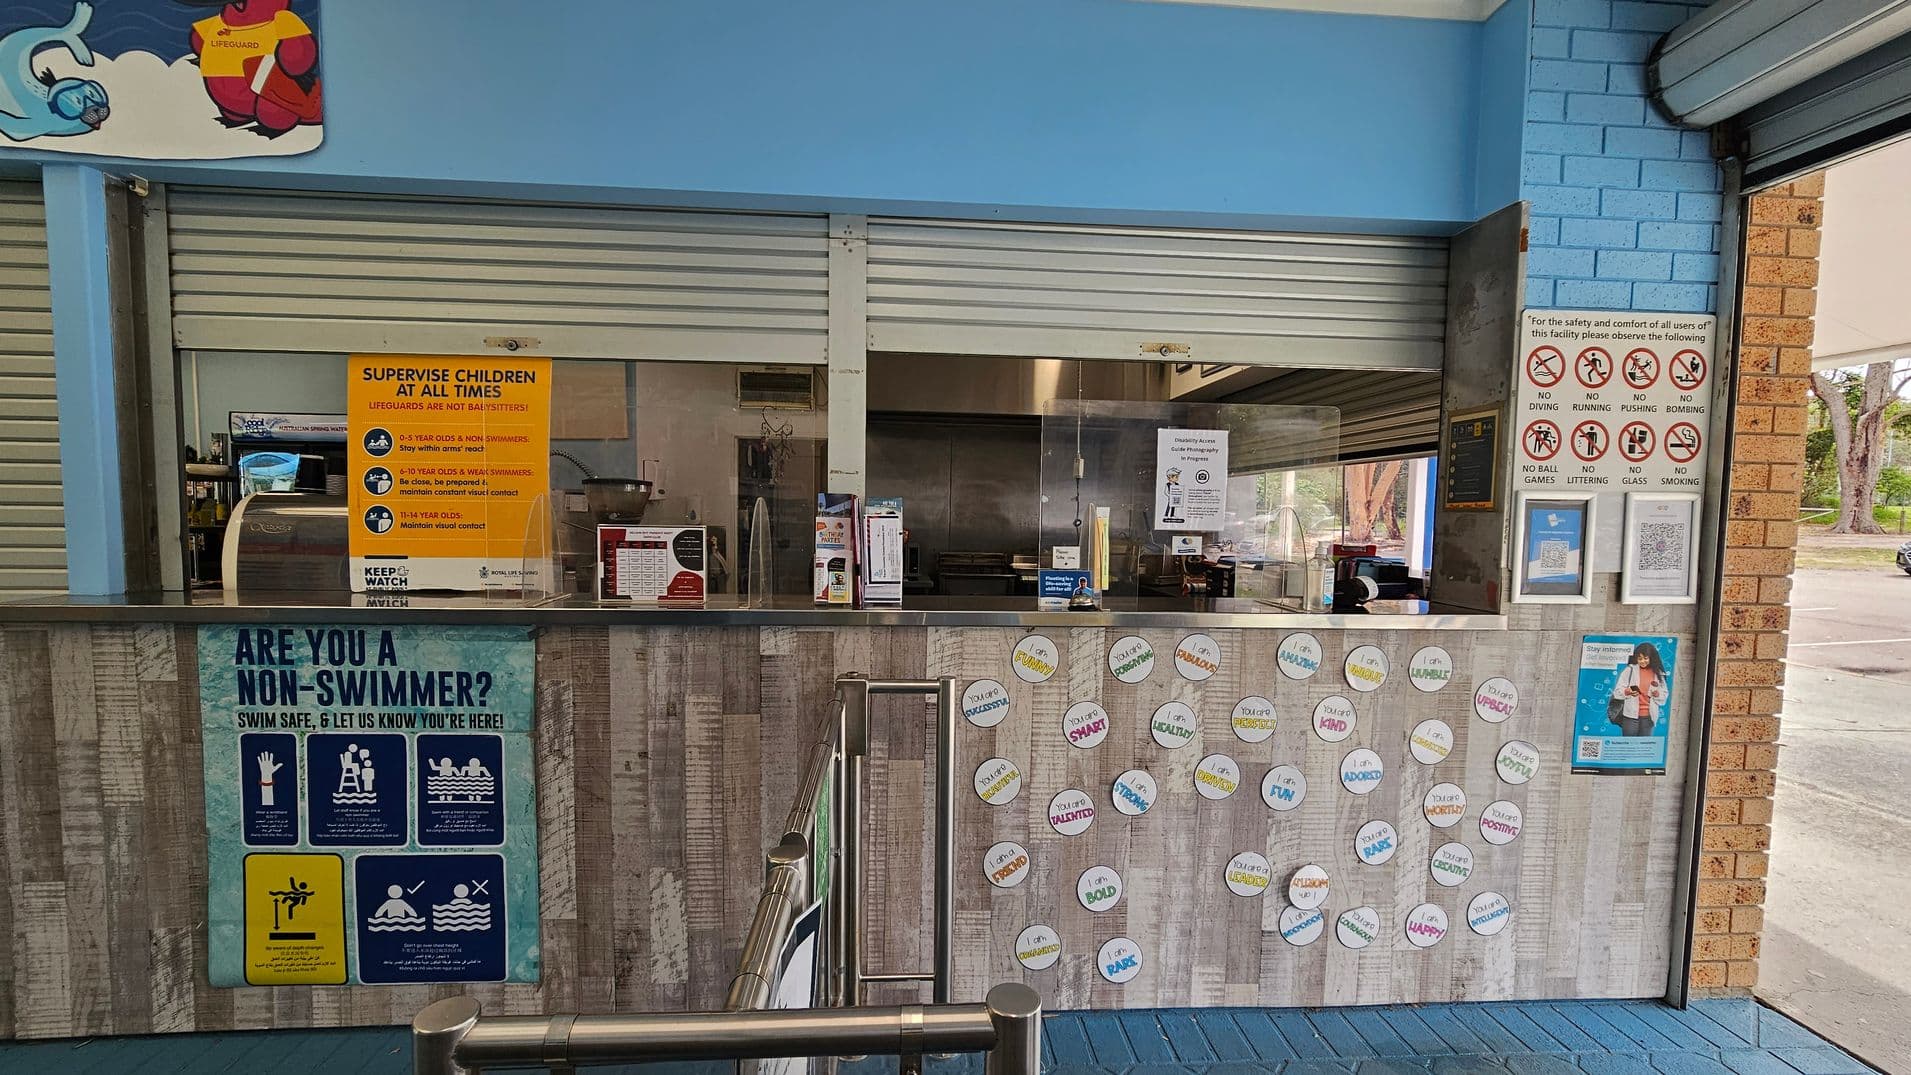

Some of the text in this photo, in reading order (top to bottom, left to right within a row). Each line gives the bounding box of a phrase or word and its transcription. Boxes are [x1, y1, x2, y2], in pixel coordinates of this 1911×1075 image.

[211, 40, 259, 49] LIFEGUARD
[1531, 317, 1546, 326] For
[1549, 318, 1563, 326] the
[1565, 318, 1592, 328] safety
[1594, 319, 1610, 327] and
[1613, 319, 1647, 328] comfort
[1650, 320, 1659, 329] of
[1661, 321, 1671, 329] all
[1532, 330, 1706, 344] this facility please observe the following
[363, 368, 536, 383] SUPERVISE CHILDREN
[396, 384, 501, 398] AT ALL TIMES
[369, 402, 424, 410] LIFEGUARDS
[468, 403, 528, 411] BABYSITTERS!
[1529, 403, 1559, 411] DIVING
[1572, 404, 1611, 412] RUNNING
[1621, 405, 1657, 413] PUSHING
[466, 435, 530, 443] NONSWIMMERS:
[1538, 465, 1558, 473] BALL
[1629, 466, 1641, 474] NO
[413, 478, 432, 486] close,
[446, 479, 480, 487] prepared
[1524, 476, 1555, 484] GAMES
[1622, 477, 1647, 485] GLASS
[1661, 478, 1699, 486] SMOKING
[364, 567, 396, 576] KEEP
[365, 577, 408, 586] WATCH
[235, 629, 398, 666] ARE YOU A
[1586, 645, 1600, 653] Stay
[1014, 650, 1055, 677] FUNNY
[1176, 649, 1218, 673] FABULOUS
[1279, 650, 1318, 672] AMAZING
[1348, 662, 1384, 684] UNIQUE
[1411, 668, 1450, 680] HUMBLE
[237, 669, 493, 707] NON-SWIMMER?
[965, 698, 1009, 718] SUCCESSFUL
[1477, 694, 1514, 715] UPBEAT
[237, 712, 504, 730] SWIM SAFE, & LET US KNOW YOU'RE HERE!
[1233, 717, 1276, 729] PERFECT
[1319, 716, 1347, 732] KIND
[1069, 718, 1106, 742] SMART
[1153, 720, 1195, 739] HEALTHY
[1498, 755, 1532, 779] JOYFUL
[1196, 770, 1235, 793] DRIVEN
[1343, 770, 1382, 782] ADORED
[1114, 781, 1149, 812] STRONG
[1269, 784, 1295, 801] FUN
[1050, 808, 1094, 825] TALENTED
[1426, 804, 1465, 816] WORTHY
[1482, 818, 1518, 836] POSITIVE
[1362, 837, 1392, 859] RARE
[991, 855, 1027, 883] FRIEND
[1433, 858, 1469, 877] CREATIVE
[1228, 870, 1268, 888] LEADER
[1085, 885, 1117, 904] BOLD
[1408, 921, 1445, 939] HAPPY
[1106, 954, 1138, 977] RARE
